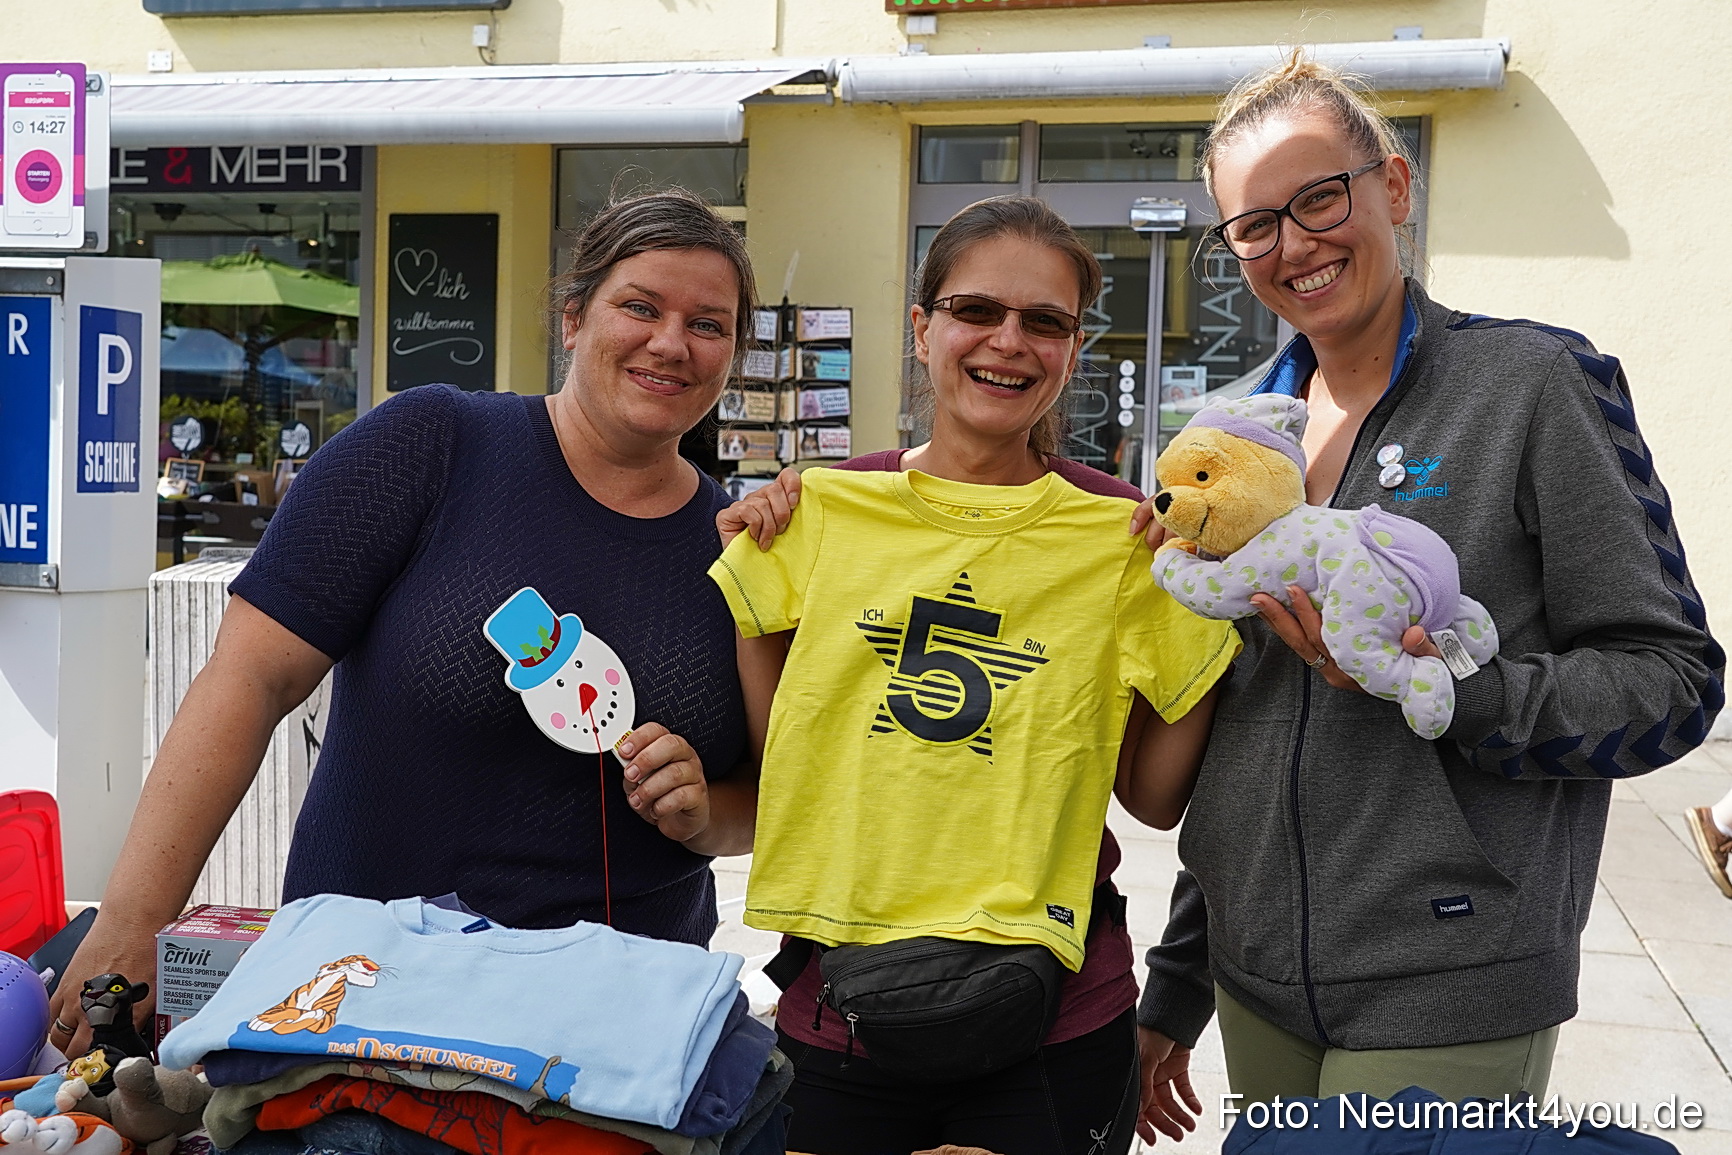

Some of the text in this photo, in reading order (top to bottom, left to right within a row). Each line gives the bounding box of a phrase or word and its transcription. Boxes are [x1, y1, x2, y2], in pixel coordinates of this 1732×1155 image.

[29, 121, 66, 133] 14:27
[163, 147, 192, 184] &
[210, 145, 347, 184] MEHR
[97, 333, 132, 415] P
[84, 441, 136, 483] SCHEINE
[1394, 482, 1449, 501] hummel
[863, 609, 884, 621] ICH
[1023, 638, 1046, 655] BIN
[886, 595, 1002, 743] 5
[1439, 902, 1469, 913] hummel
[164, 947, 212, 966] crivit
[164, 966, 193, 975] SEAMLESS
[194, 969, 216, 977] SPORTS
[163, 998, 193, 1006] SEAMLESS
[327, 1037, 518, 1082] DAS DSCHUNGEL
